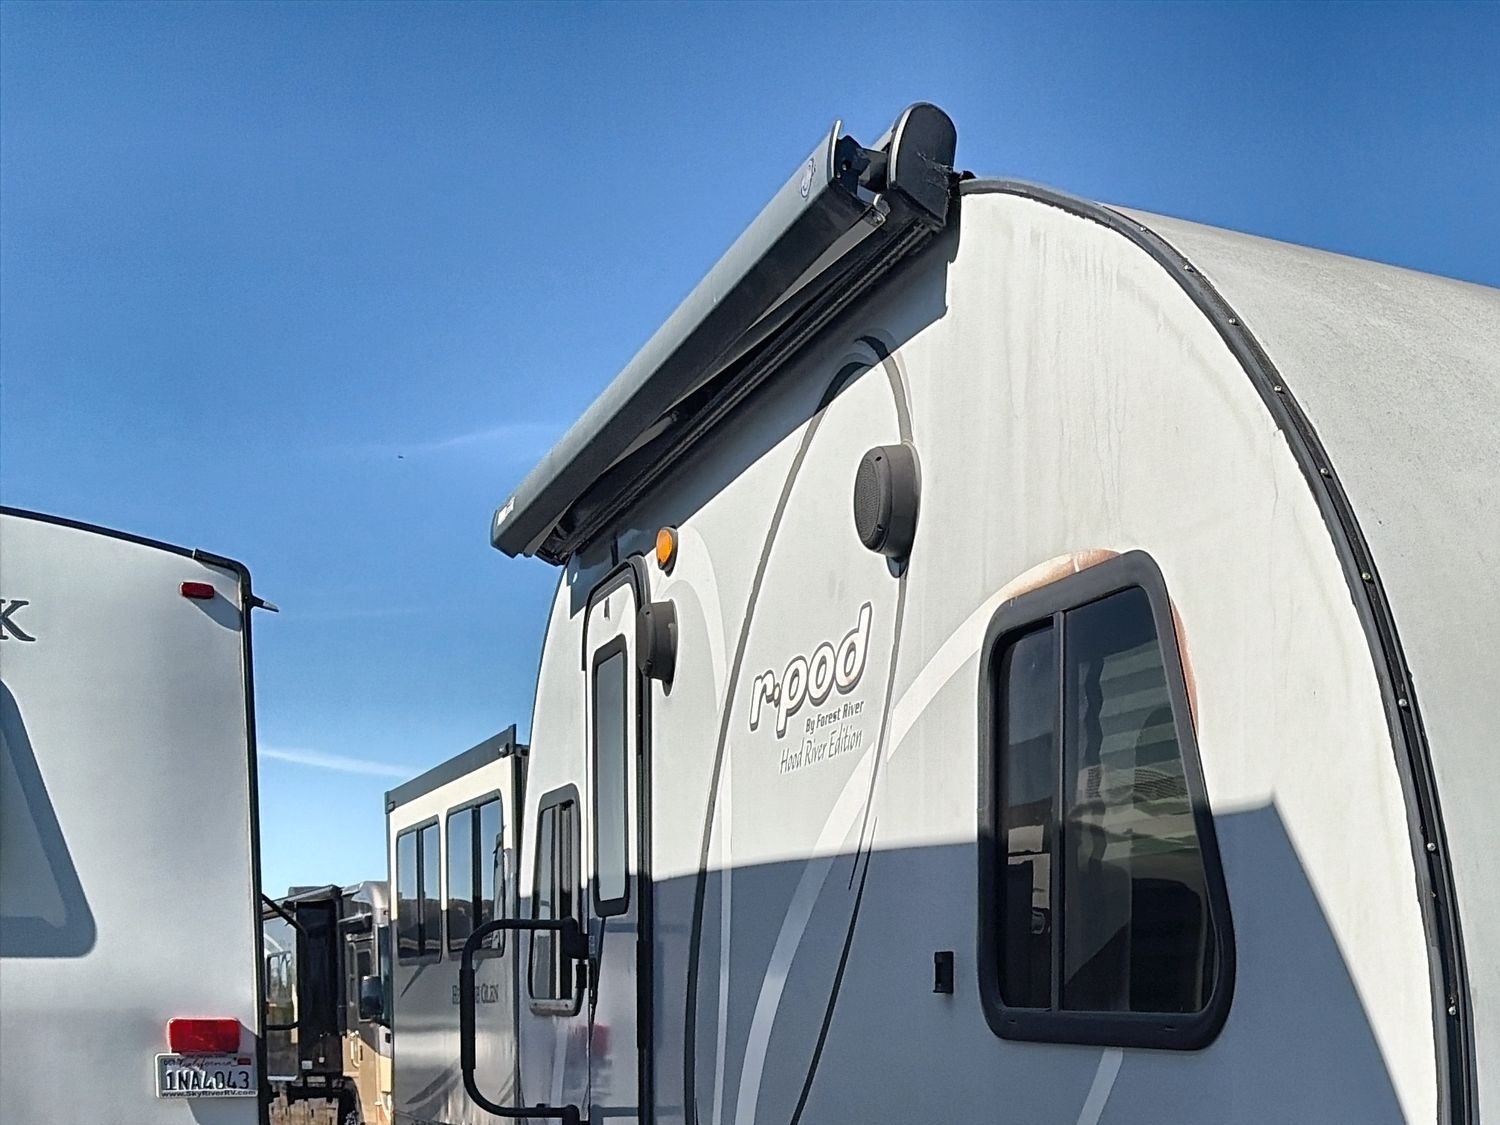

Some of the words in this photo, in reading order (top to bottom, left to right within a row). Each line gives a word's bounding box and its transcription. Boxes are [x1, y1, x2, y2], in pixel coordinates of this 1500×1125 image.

[806, 718, 816, 736] By
[816, 708, 841, 729] Forest
[842, 701, 864, 719] River
[780, 737, 805, 774] Hood
[805, 738, 828, 766] River
[828, 723, 863, 758] Edition
[165, 1071, 250, 1090] 1NA4043
